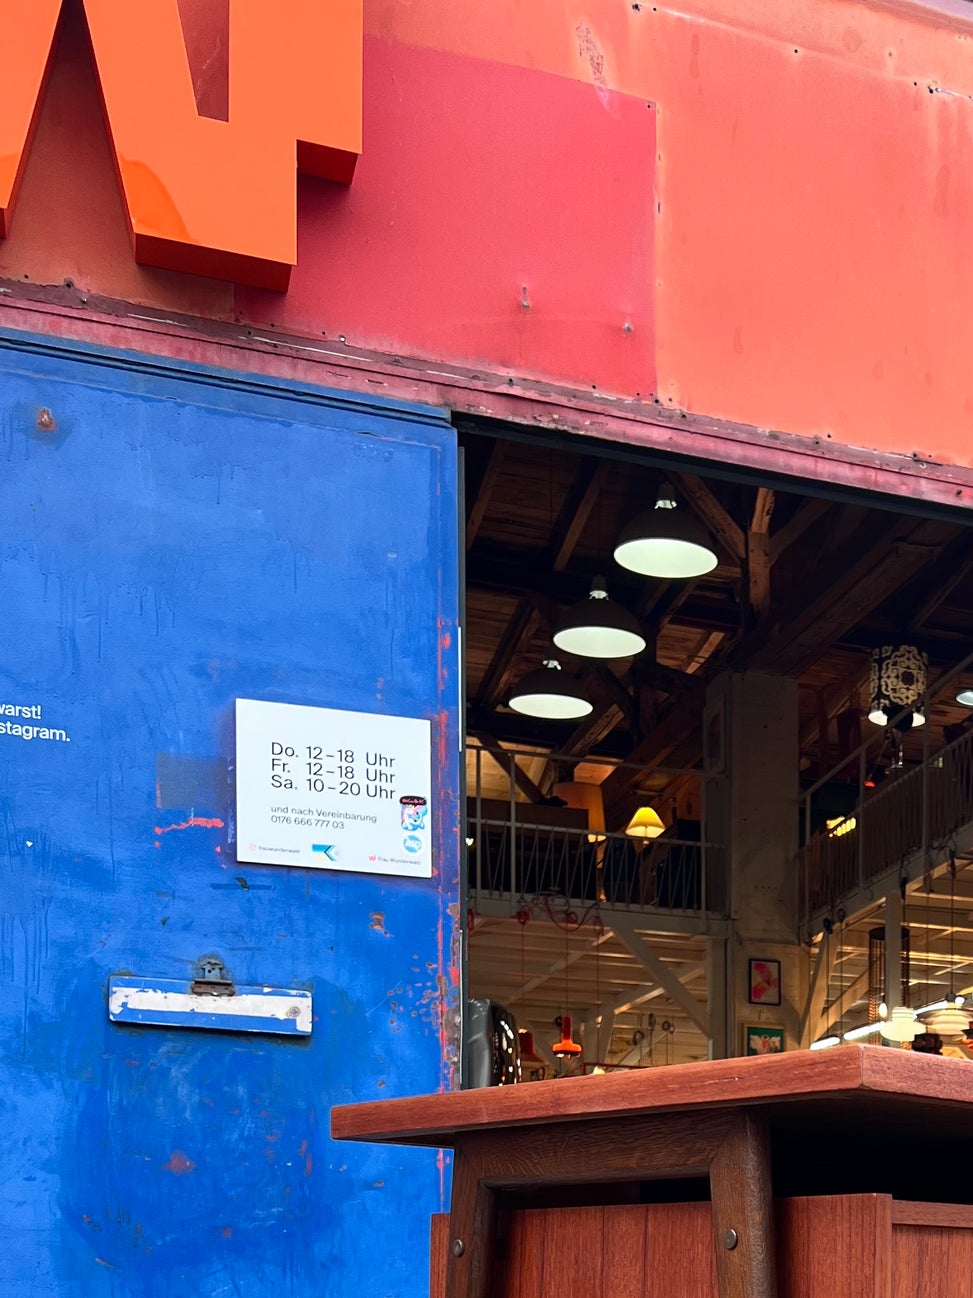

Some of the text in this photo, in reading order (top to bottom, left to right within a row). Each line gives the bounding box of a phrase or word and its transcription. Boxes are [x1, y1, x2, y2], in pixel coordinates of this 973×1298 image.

[271, 741, 299, 758] Do.
[366, 752, 396, 768] Uhr
[271, 758, 291, 773] Fr.
[366, 768, 396, 784] Uhr
[271, 774, 298, 790] Sa.
[366, 784, 396, 800] Uhr
[270, 805, 377, 824] und nach Vereinbarung
[315, 818, 331, 828] 777
[332, 820, 345, 830] 03
